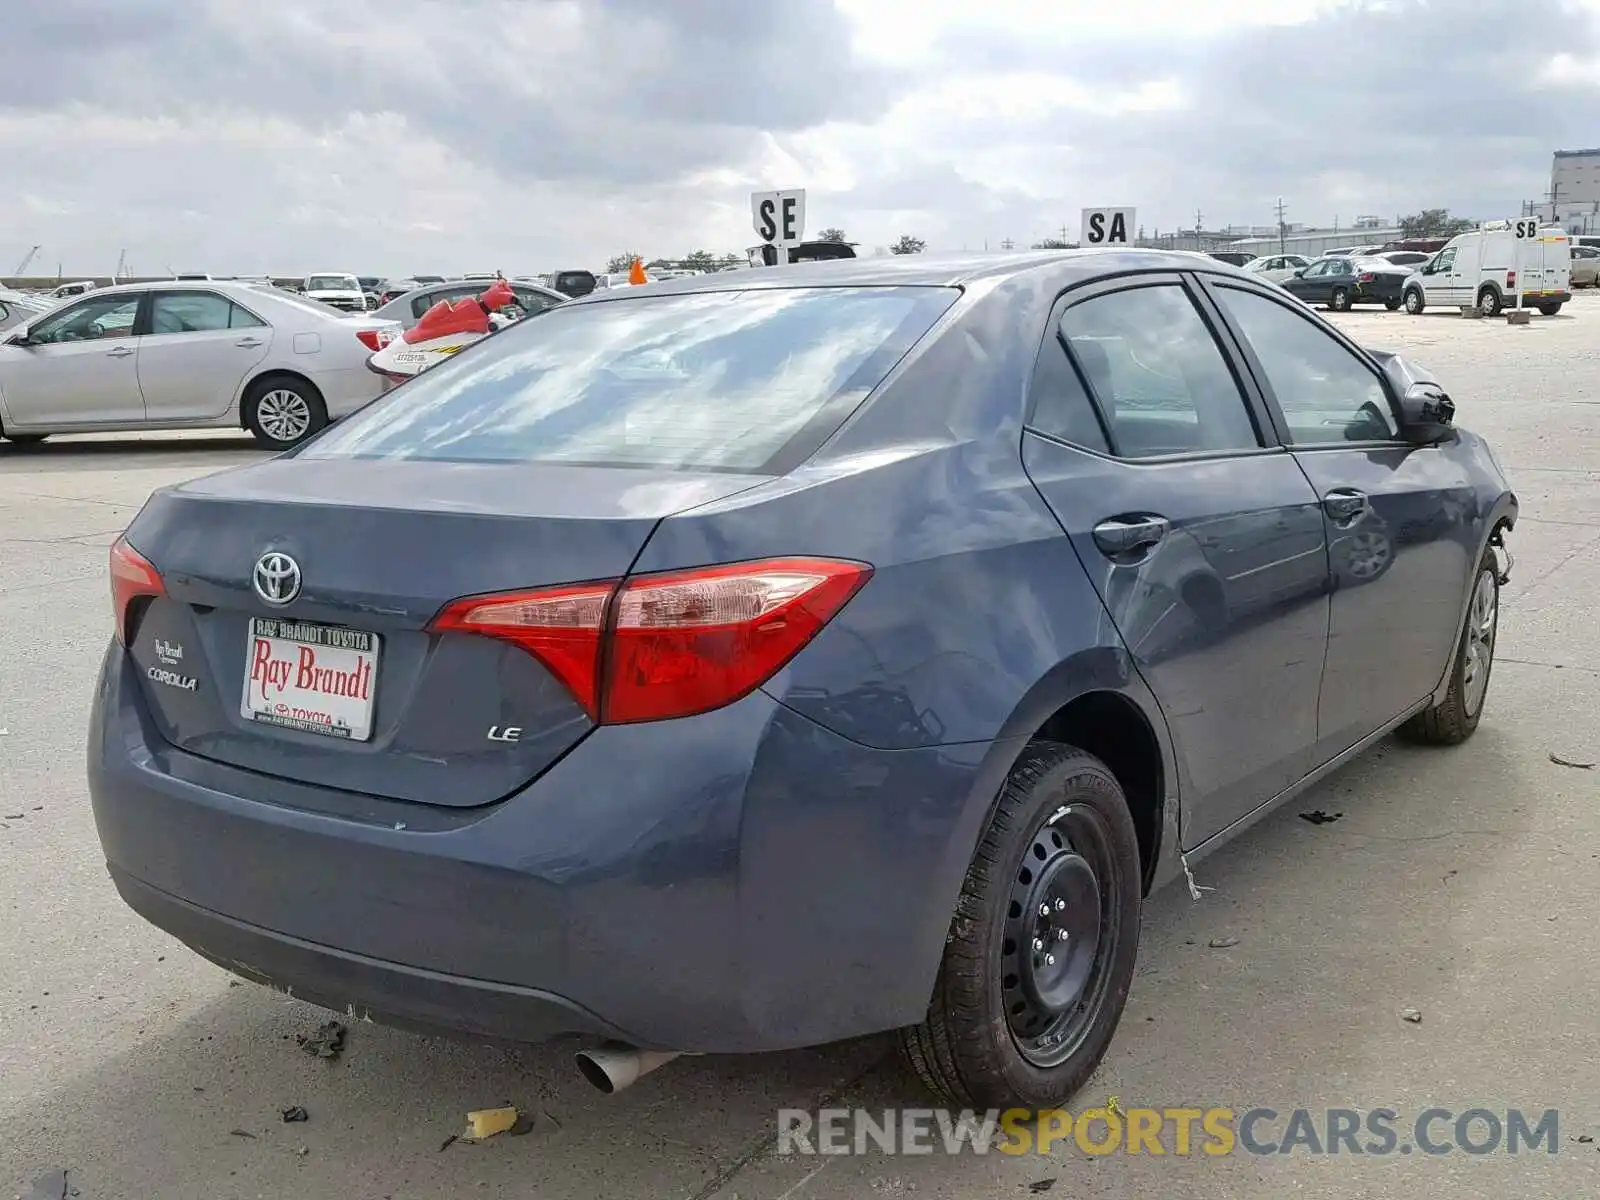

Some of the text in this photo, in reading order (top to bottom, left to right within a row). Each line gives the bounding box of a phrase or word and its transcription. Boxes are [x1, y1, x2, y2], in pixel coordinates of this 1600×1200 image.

[760, 198, 796, 242] SE
[1087, 212, 1127, 243] SA
[1516, 221, 1536, 239] SB
[256, 620, 369, 650] RAY BRANDT TOYOTA
[147, 667, 197, 692] COROLLA
[251, 639, 372, 701] Ray Brandt
[291, 707, 333, 725] TOYOTA
[487, 725, 523, 742] LE
